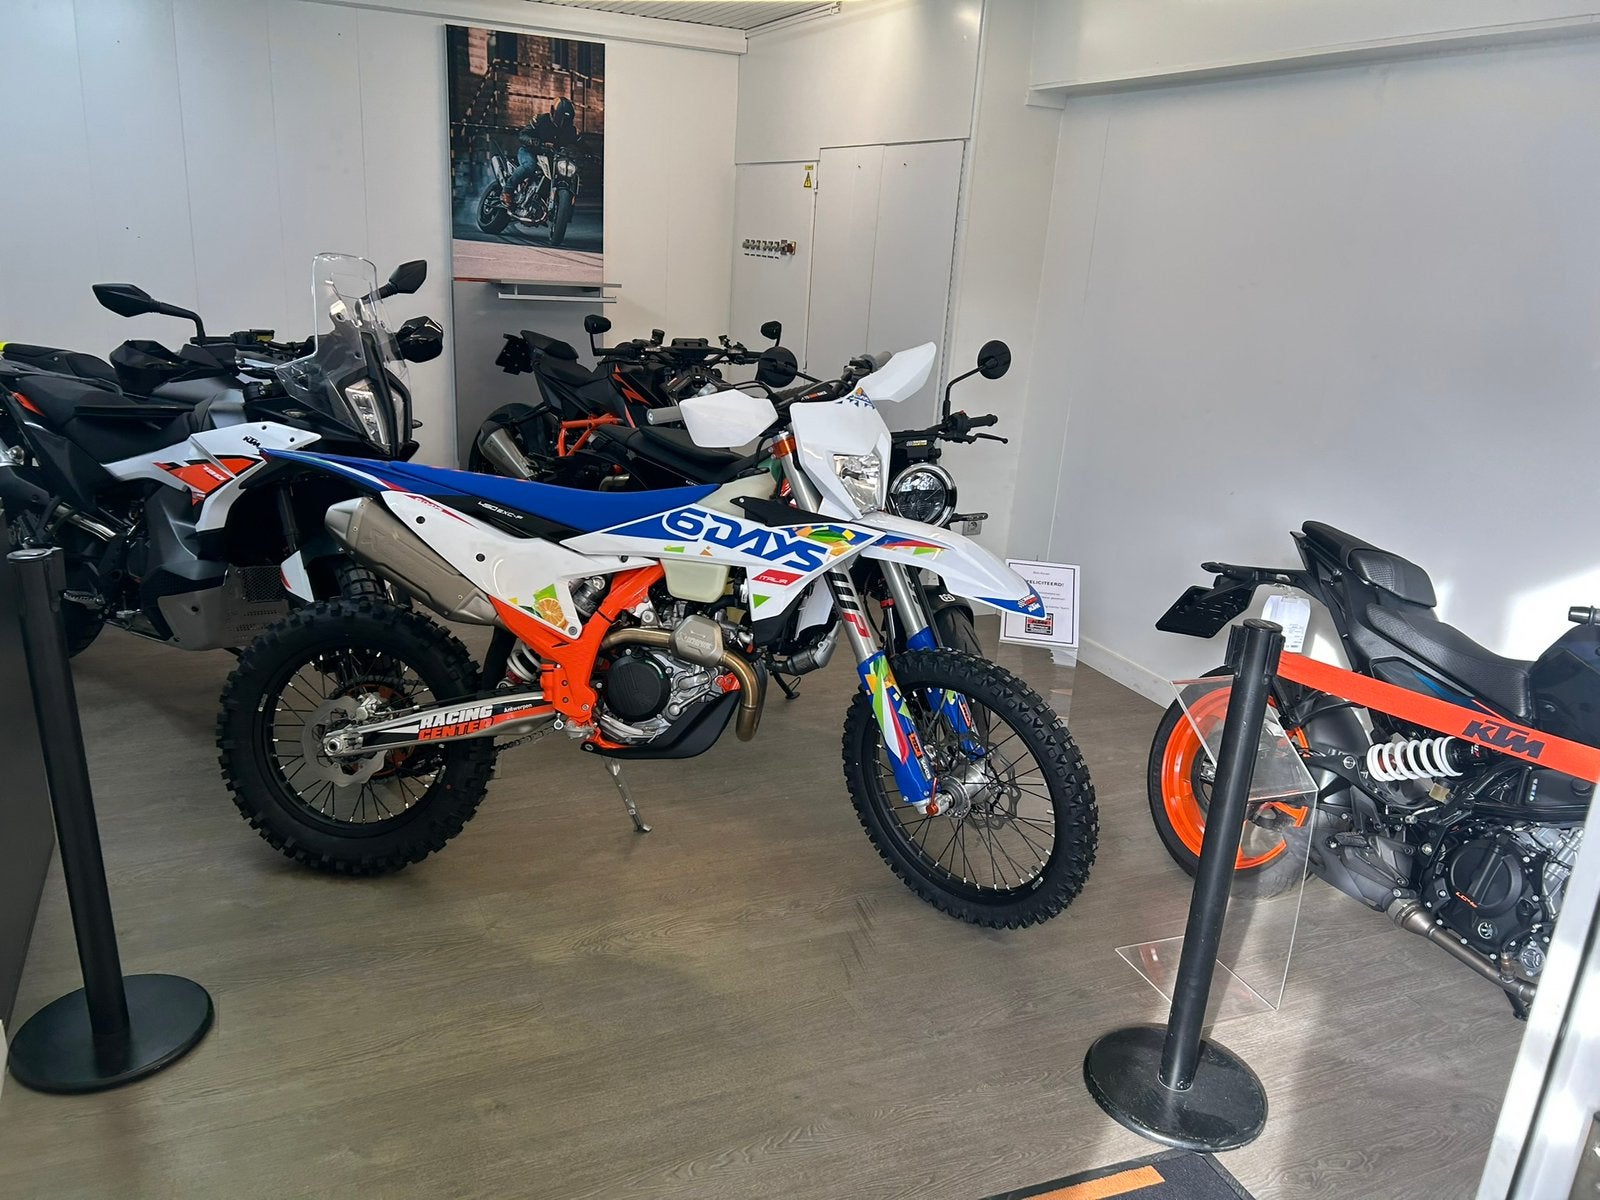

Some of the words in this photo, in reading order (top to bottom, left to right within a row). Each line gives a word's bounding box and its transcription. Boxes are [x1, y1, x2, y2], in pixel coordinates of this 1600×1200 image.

[242, 436, 261, 448] KTM
[665, 507, 829, 573] 6DAYS
[758, 575, 789, 585] ITALIA
[418, 717, 494, 741] CENTER
[419, 704, 494, 730] RACING
[1461, 719, 1546, 759] KTM
